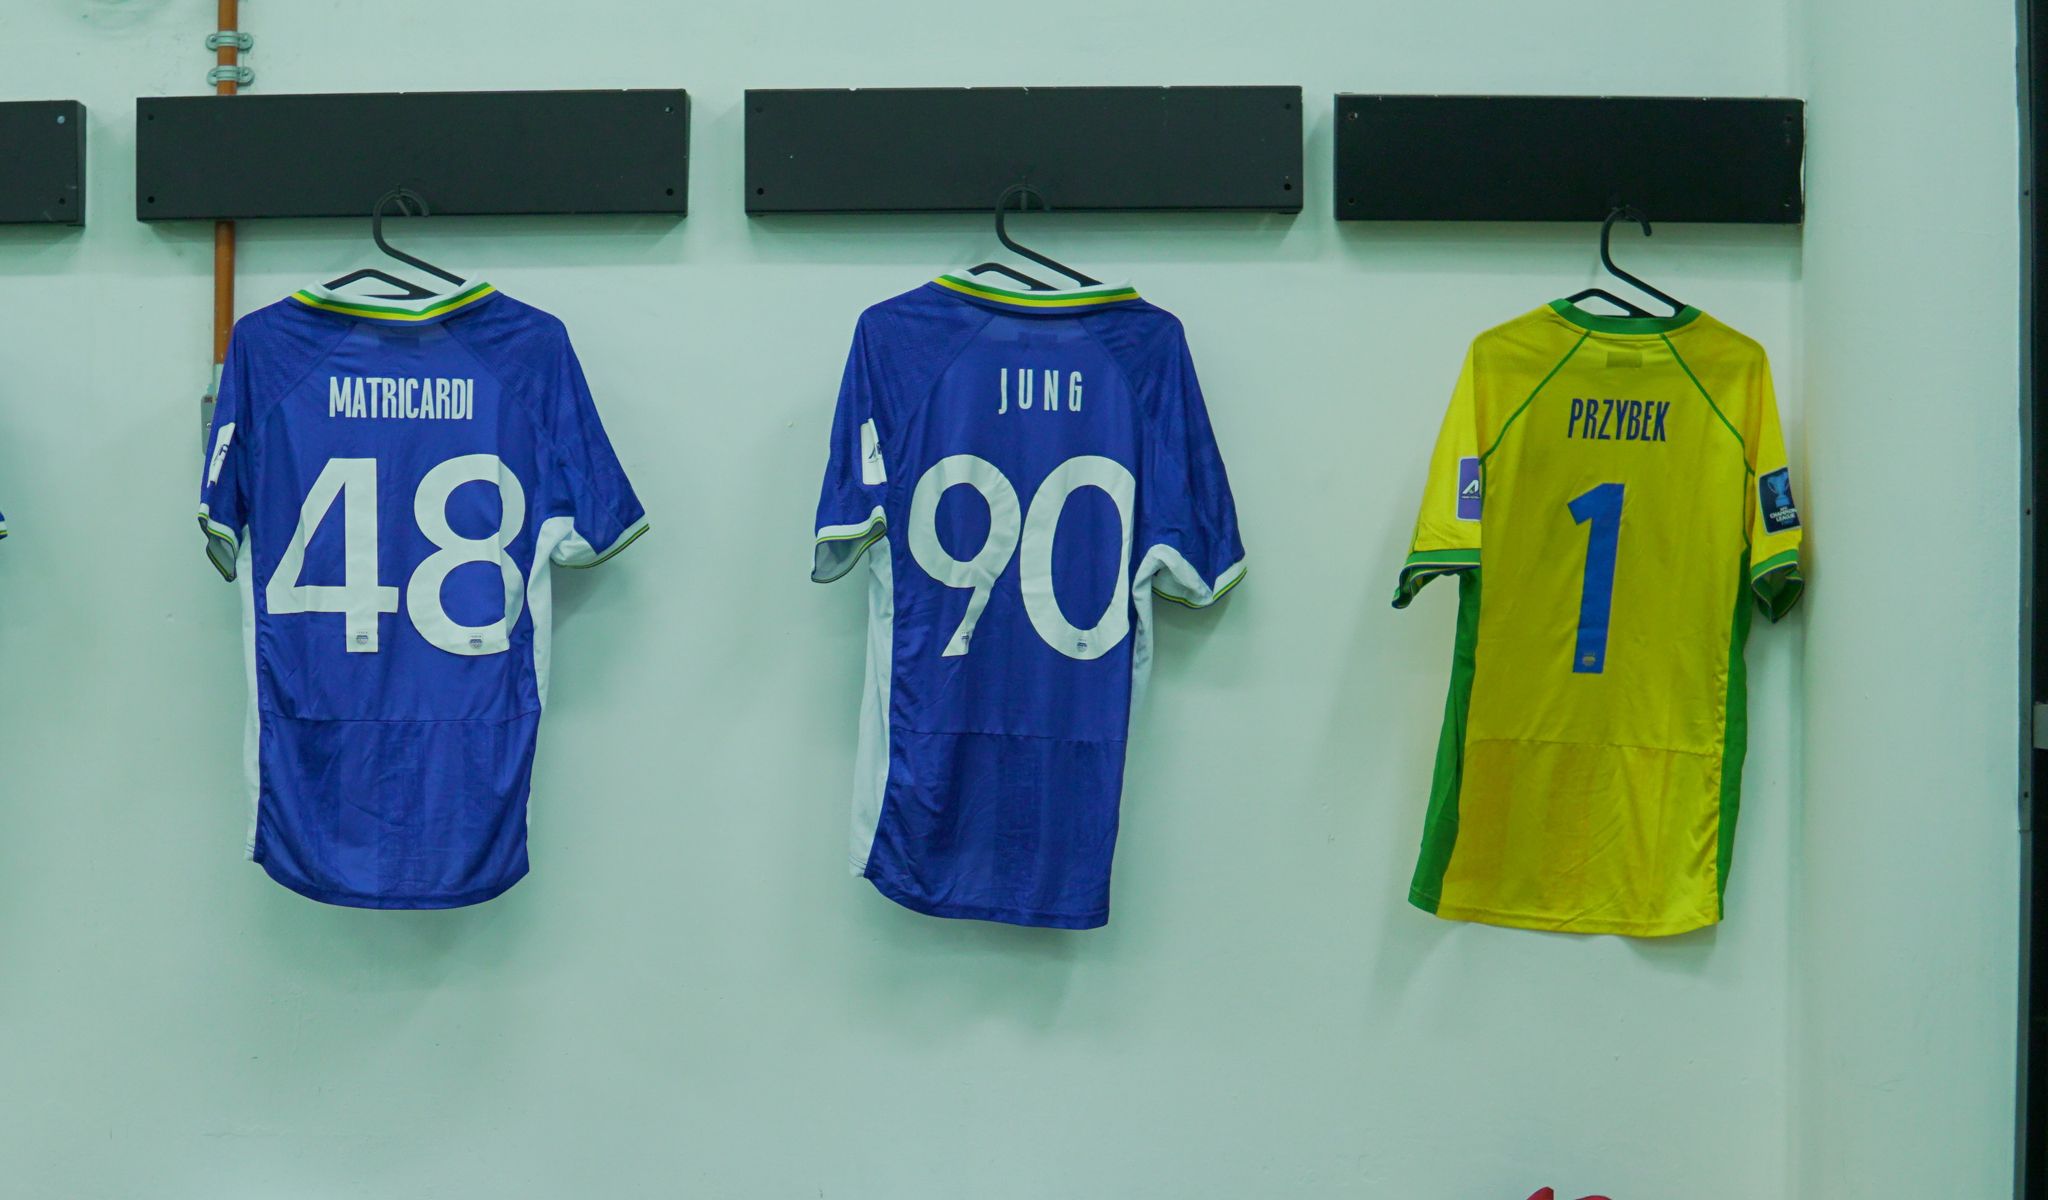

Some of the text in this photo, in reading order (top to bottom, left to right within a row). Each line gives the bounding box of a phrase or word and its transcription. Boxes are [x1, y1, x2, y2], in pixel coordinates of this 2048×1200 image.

[329, 376, 474, 420] MATRICARDI
[998, 367, 1083, 415] JUNG
[1567, 398, 1670, 442] PRZYBEK
[266, 453, 526, 656] 48
[908, 453, 1135, 660] 90
[1568, 483, 1625, 674] 1
